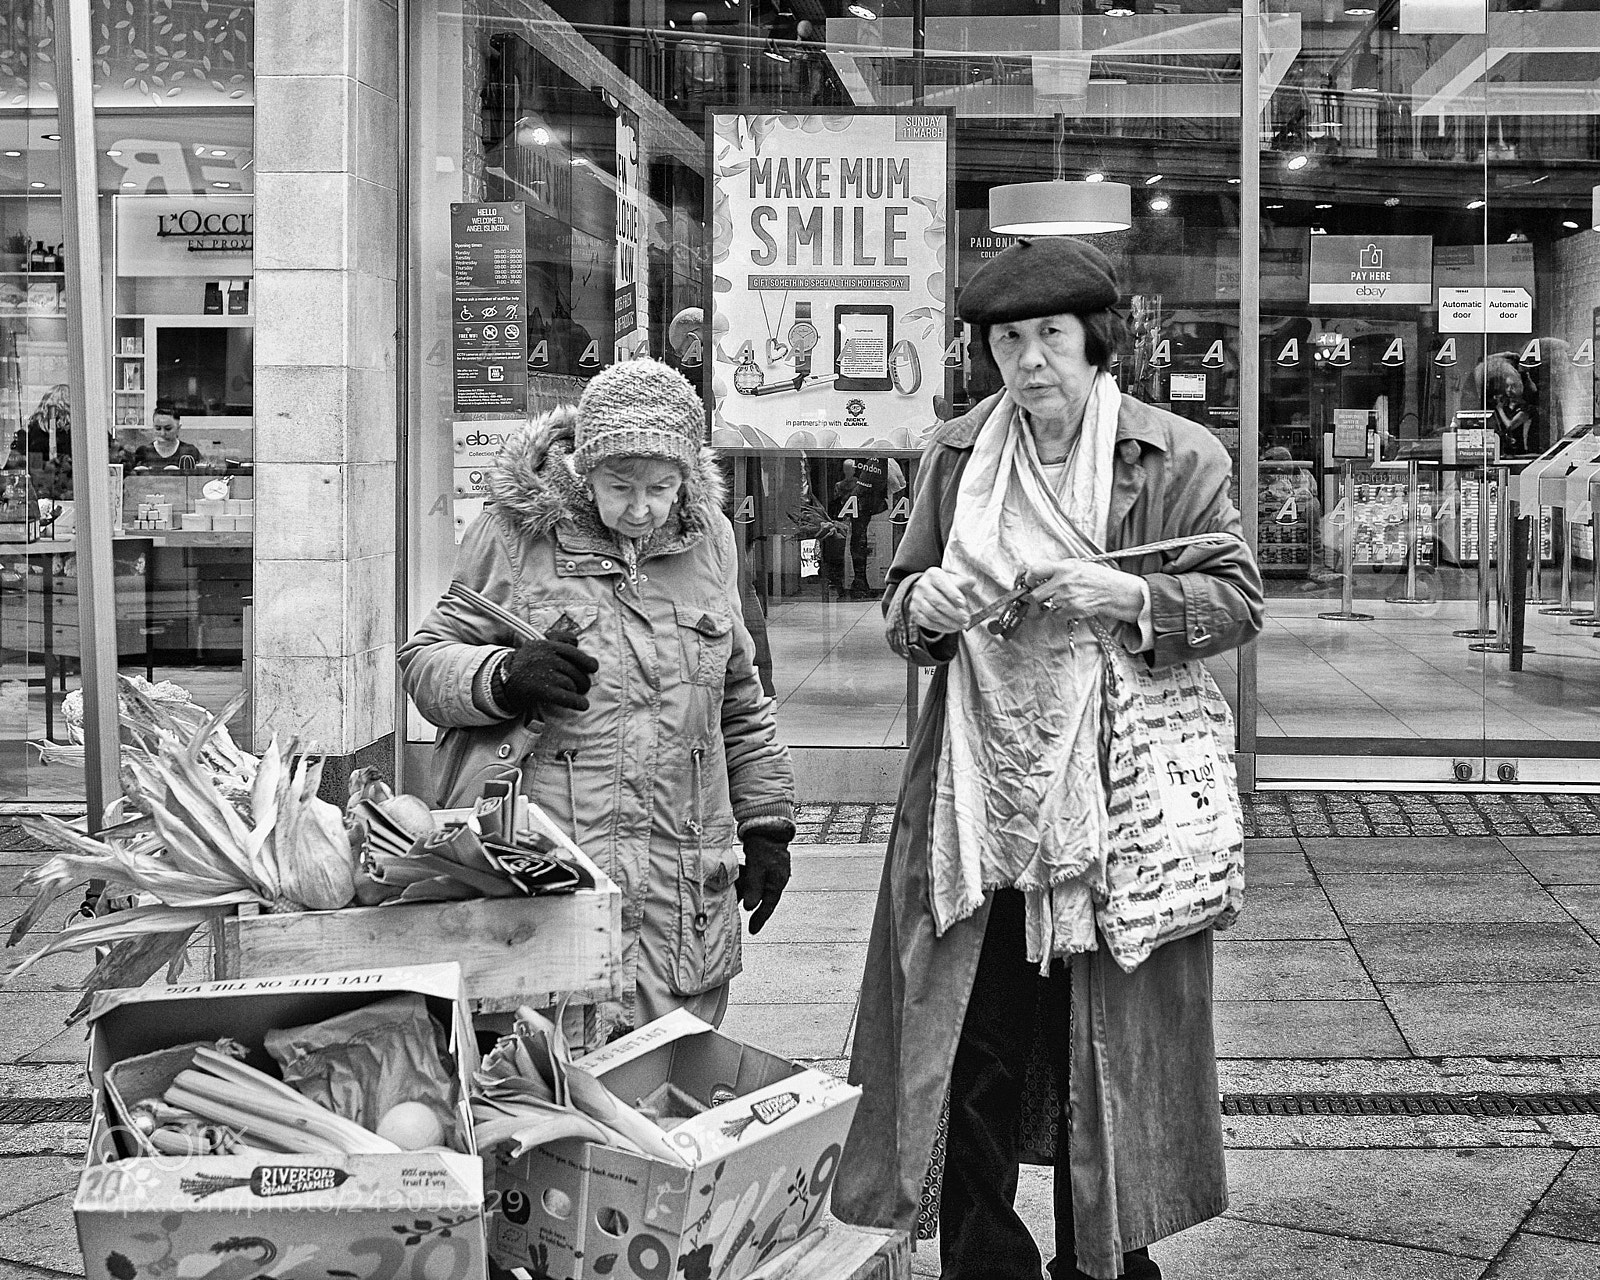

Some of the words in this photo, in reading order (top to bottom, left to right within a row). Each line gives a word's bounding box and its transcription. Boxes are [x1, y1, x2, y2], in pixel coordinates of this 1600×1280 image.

[905, 116, 941, 127] SUNDAY
[902, 127, 912, 138] 11
[913, 127, 944, 138] MARCH
[749, 157, 831, 199] MAKE
[839, 157, 910, 200] MUM
[477, 208, 497, 217] HELLO
[471, 217, 497, 225] WELCOME
[466, 225, 483, 233] ANGEL
[483, 224, 510, 232] ISLINGTON
[750, 205, 908, 267] SMILE
[188, 239, 205, 248] EN
[212, 239, 253, 248] PROV
[970, 237, 992, 248] PAID
[1350, 271, 1367, 281] PAY
[1369, 271, 1391, 281] HERE
[753, 278, 769, 287] GIFT
[770, 278, 809, 287] SOMETHING
[810, 278, 839, 287] SPECIAL
[840, 278, 856, 287] THIS
[890, 278, 905, 287] DAY
[1356, 285, 1387, 298] ebay
[1442, 300, 1483, 309] Automatic
[1488, 300, 1529, 309] Automatic
[1452, 311, 1472, 319] door
[1499, 311, 1518, 319] door
[792, 419, 828, 427] partnership
[851, 459, 882, 475] London
[255, 981, 283, 989] ON
[289, 978, 330, 988] LIFE
[336, 974, 383, 986] LIVE
[165, 986, 202, 995] VEG
[210, 982, 247, 992] THE
[261, 1167, 336, 1187] RIVERFORD
[260, 1183, 298, 1196] ORGANIC
[297, 1177, 336, 1192] FARMERS
